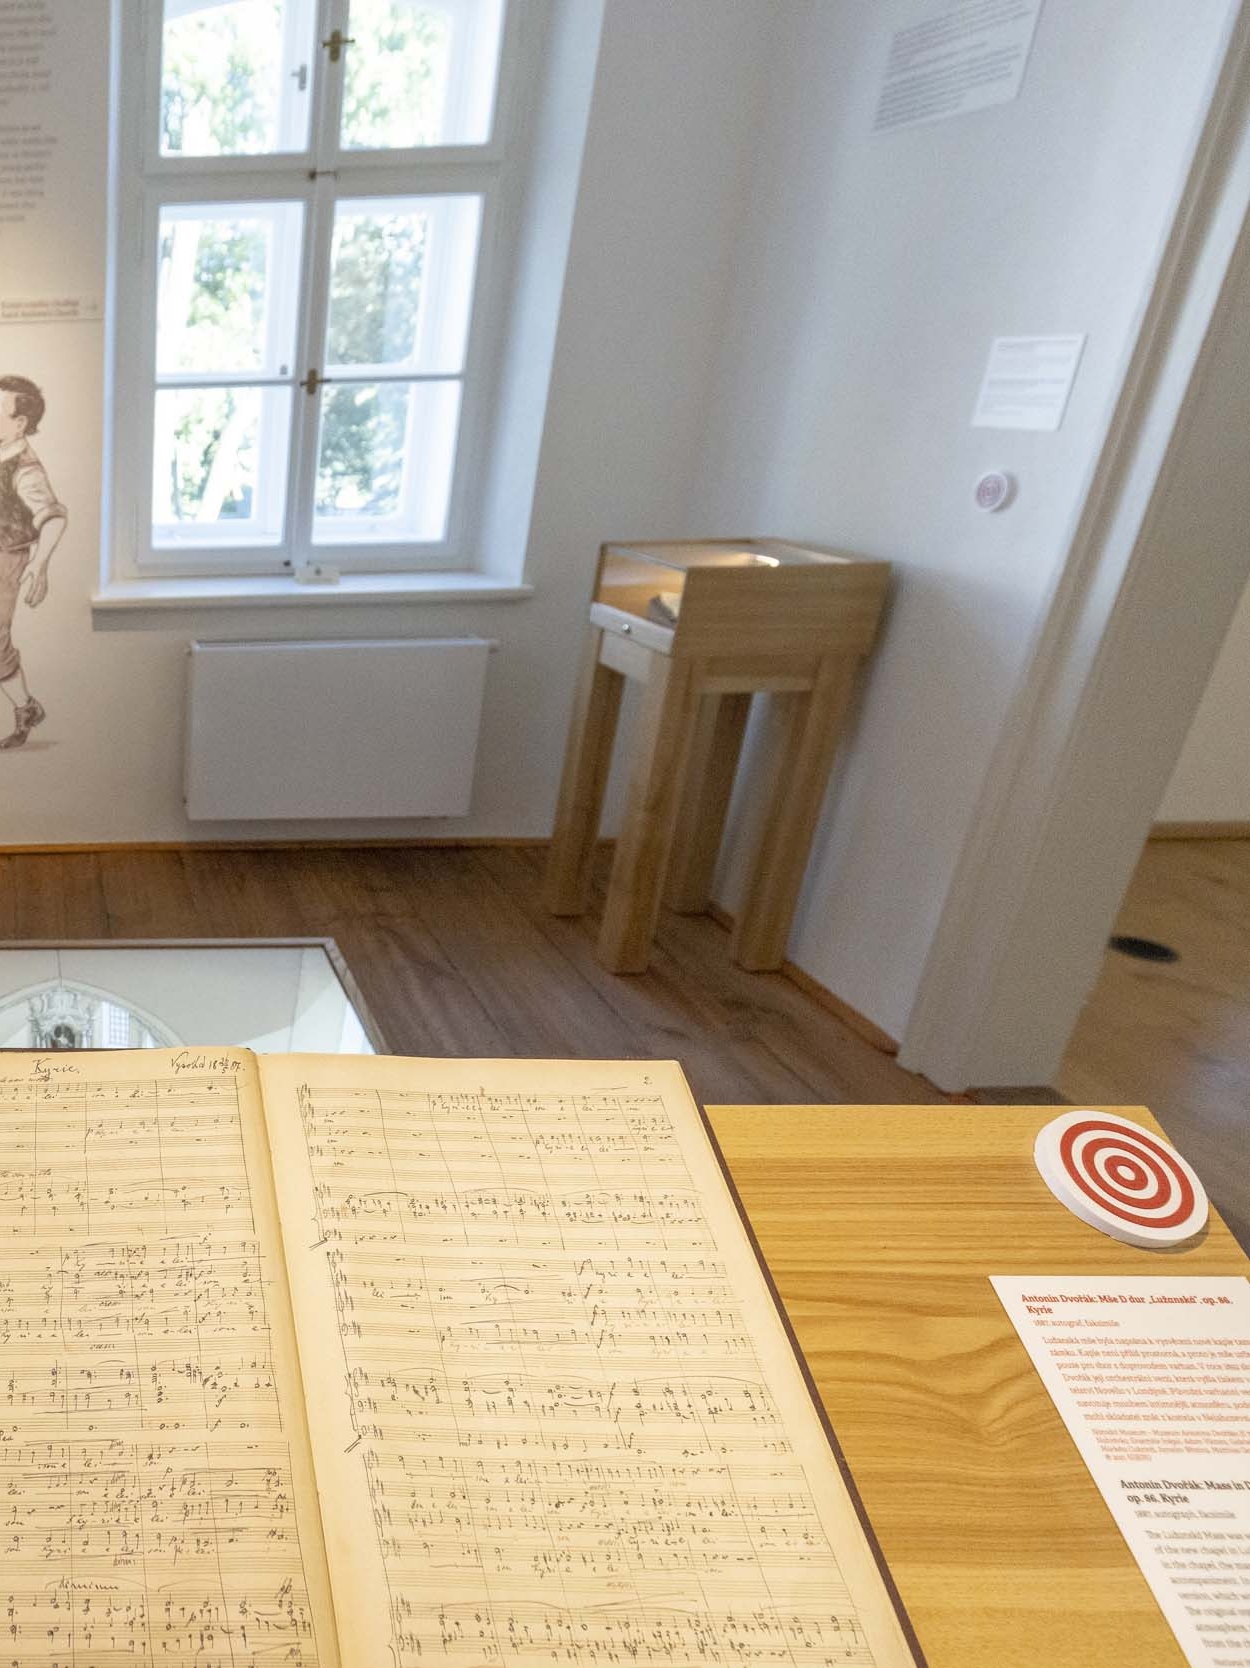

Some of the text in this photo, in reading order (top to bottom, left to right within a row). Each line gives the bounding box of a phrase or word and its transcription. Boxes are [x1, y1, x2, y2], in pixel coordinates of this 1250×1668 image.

[1025, 1304, 1054, 1315] Kyrie
[1203, 1480, 1232, 1489] Mass
[1159, 1494, 1190, 1505] Kyrie
